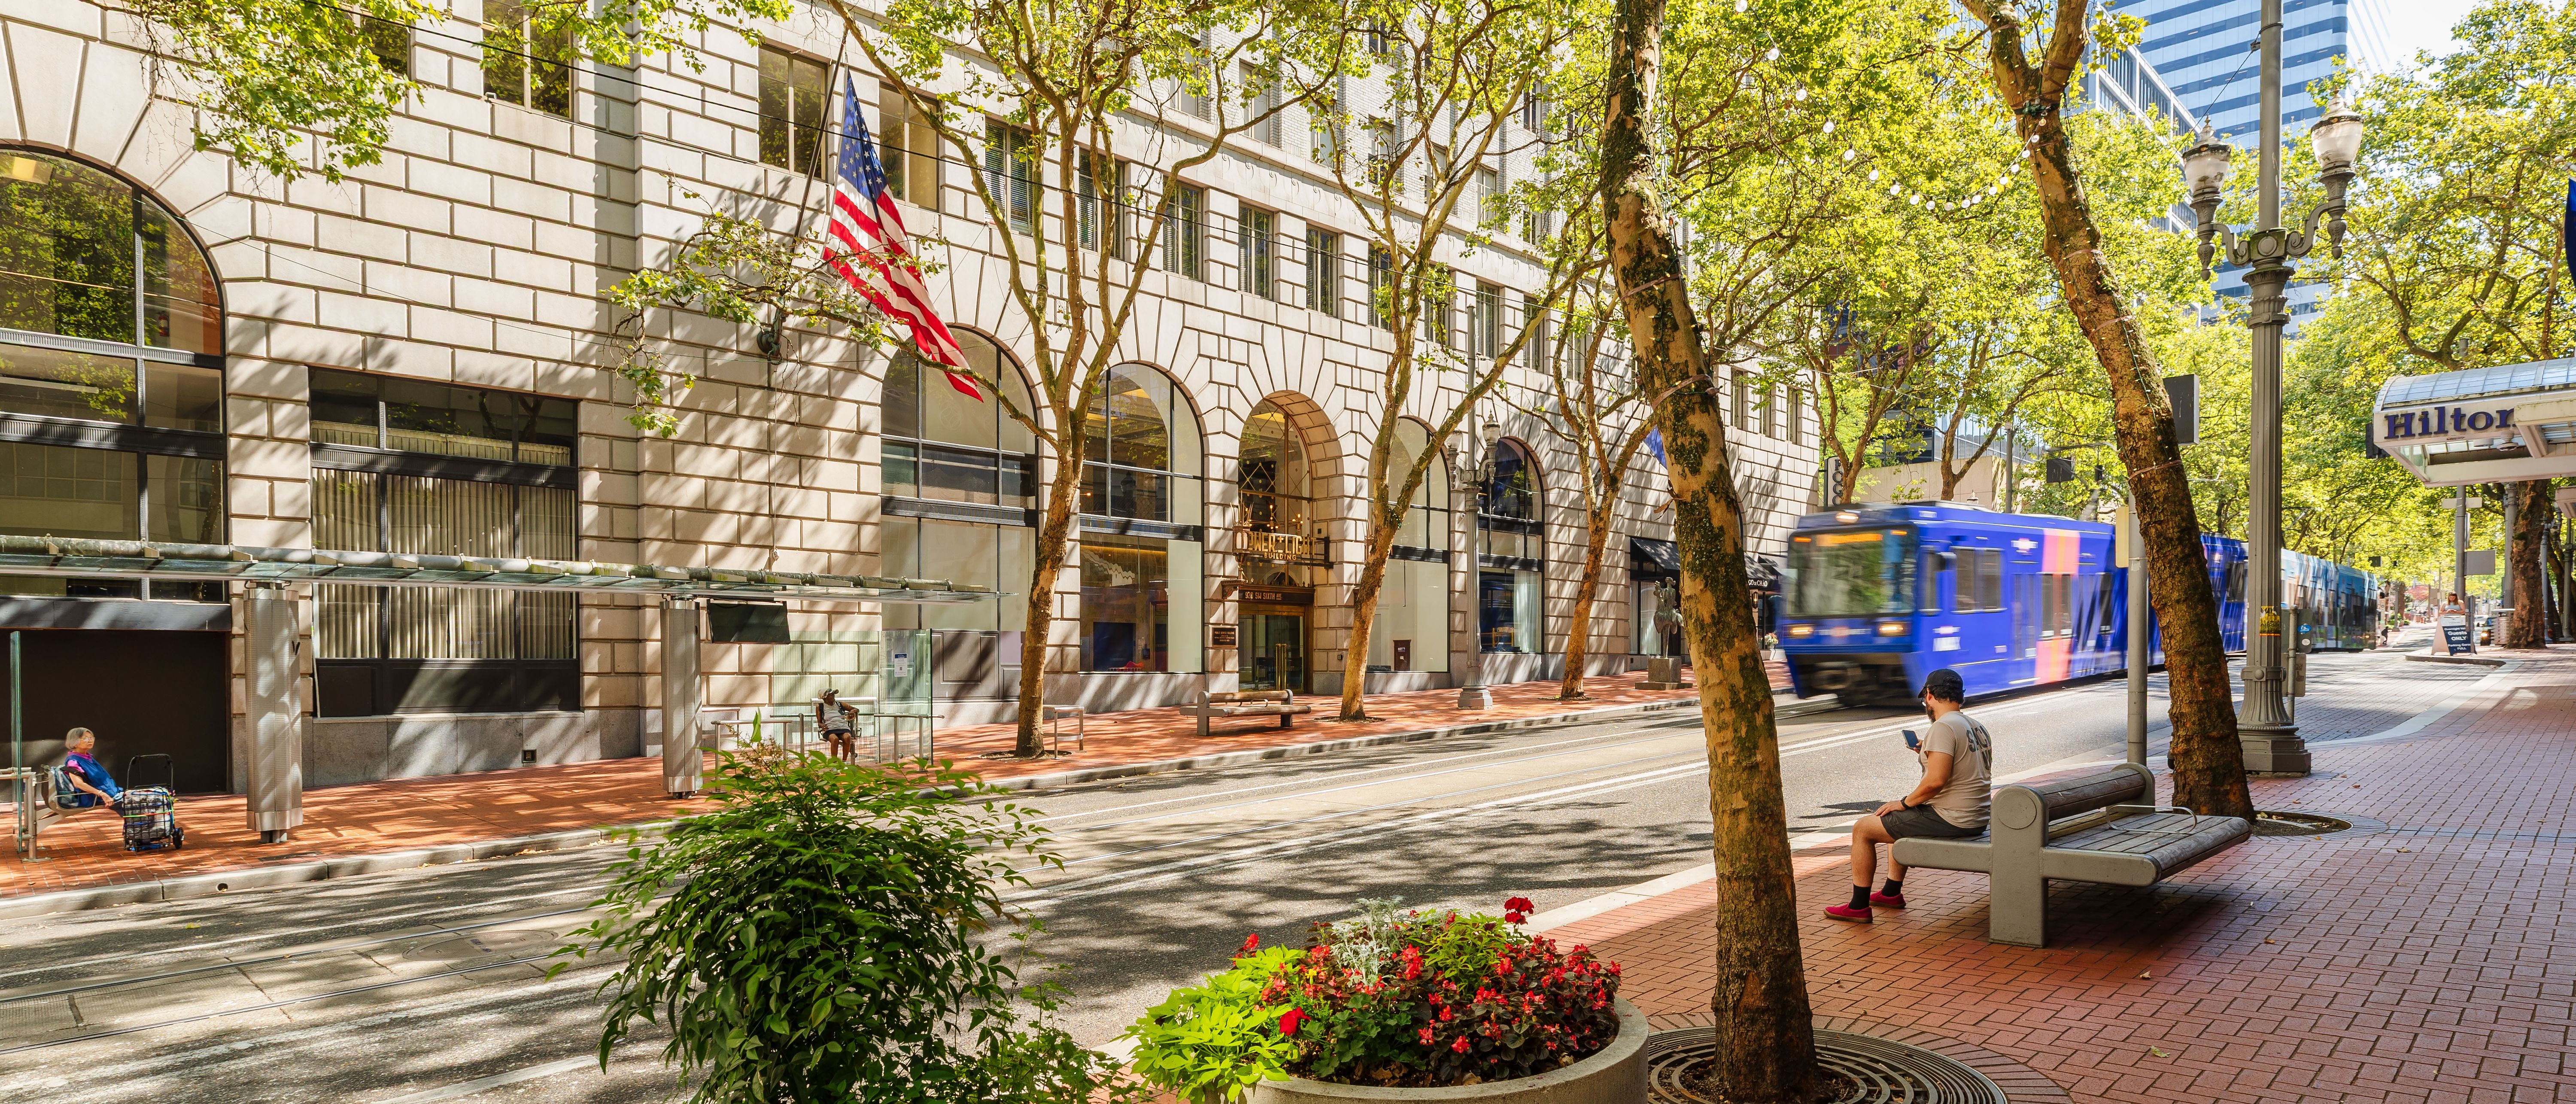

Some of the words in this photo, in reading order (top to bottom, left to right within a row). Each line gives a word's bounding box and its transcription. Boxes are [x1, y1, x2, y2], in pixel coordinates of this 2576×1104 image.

[1249, 531, 1276, 553] OWER
[1285, 535, 1317, 556] LIGHT
[1264, 552, 1297, 560] BUILDING
